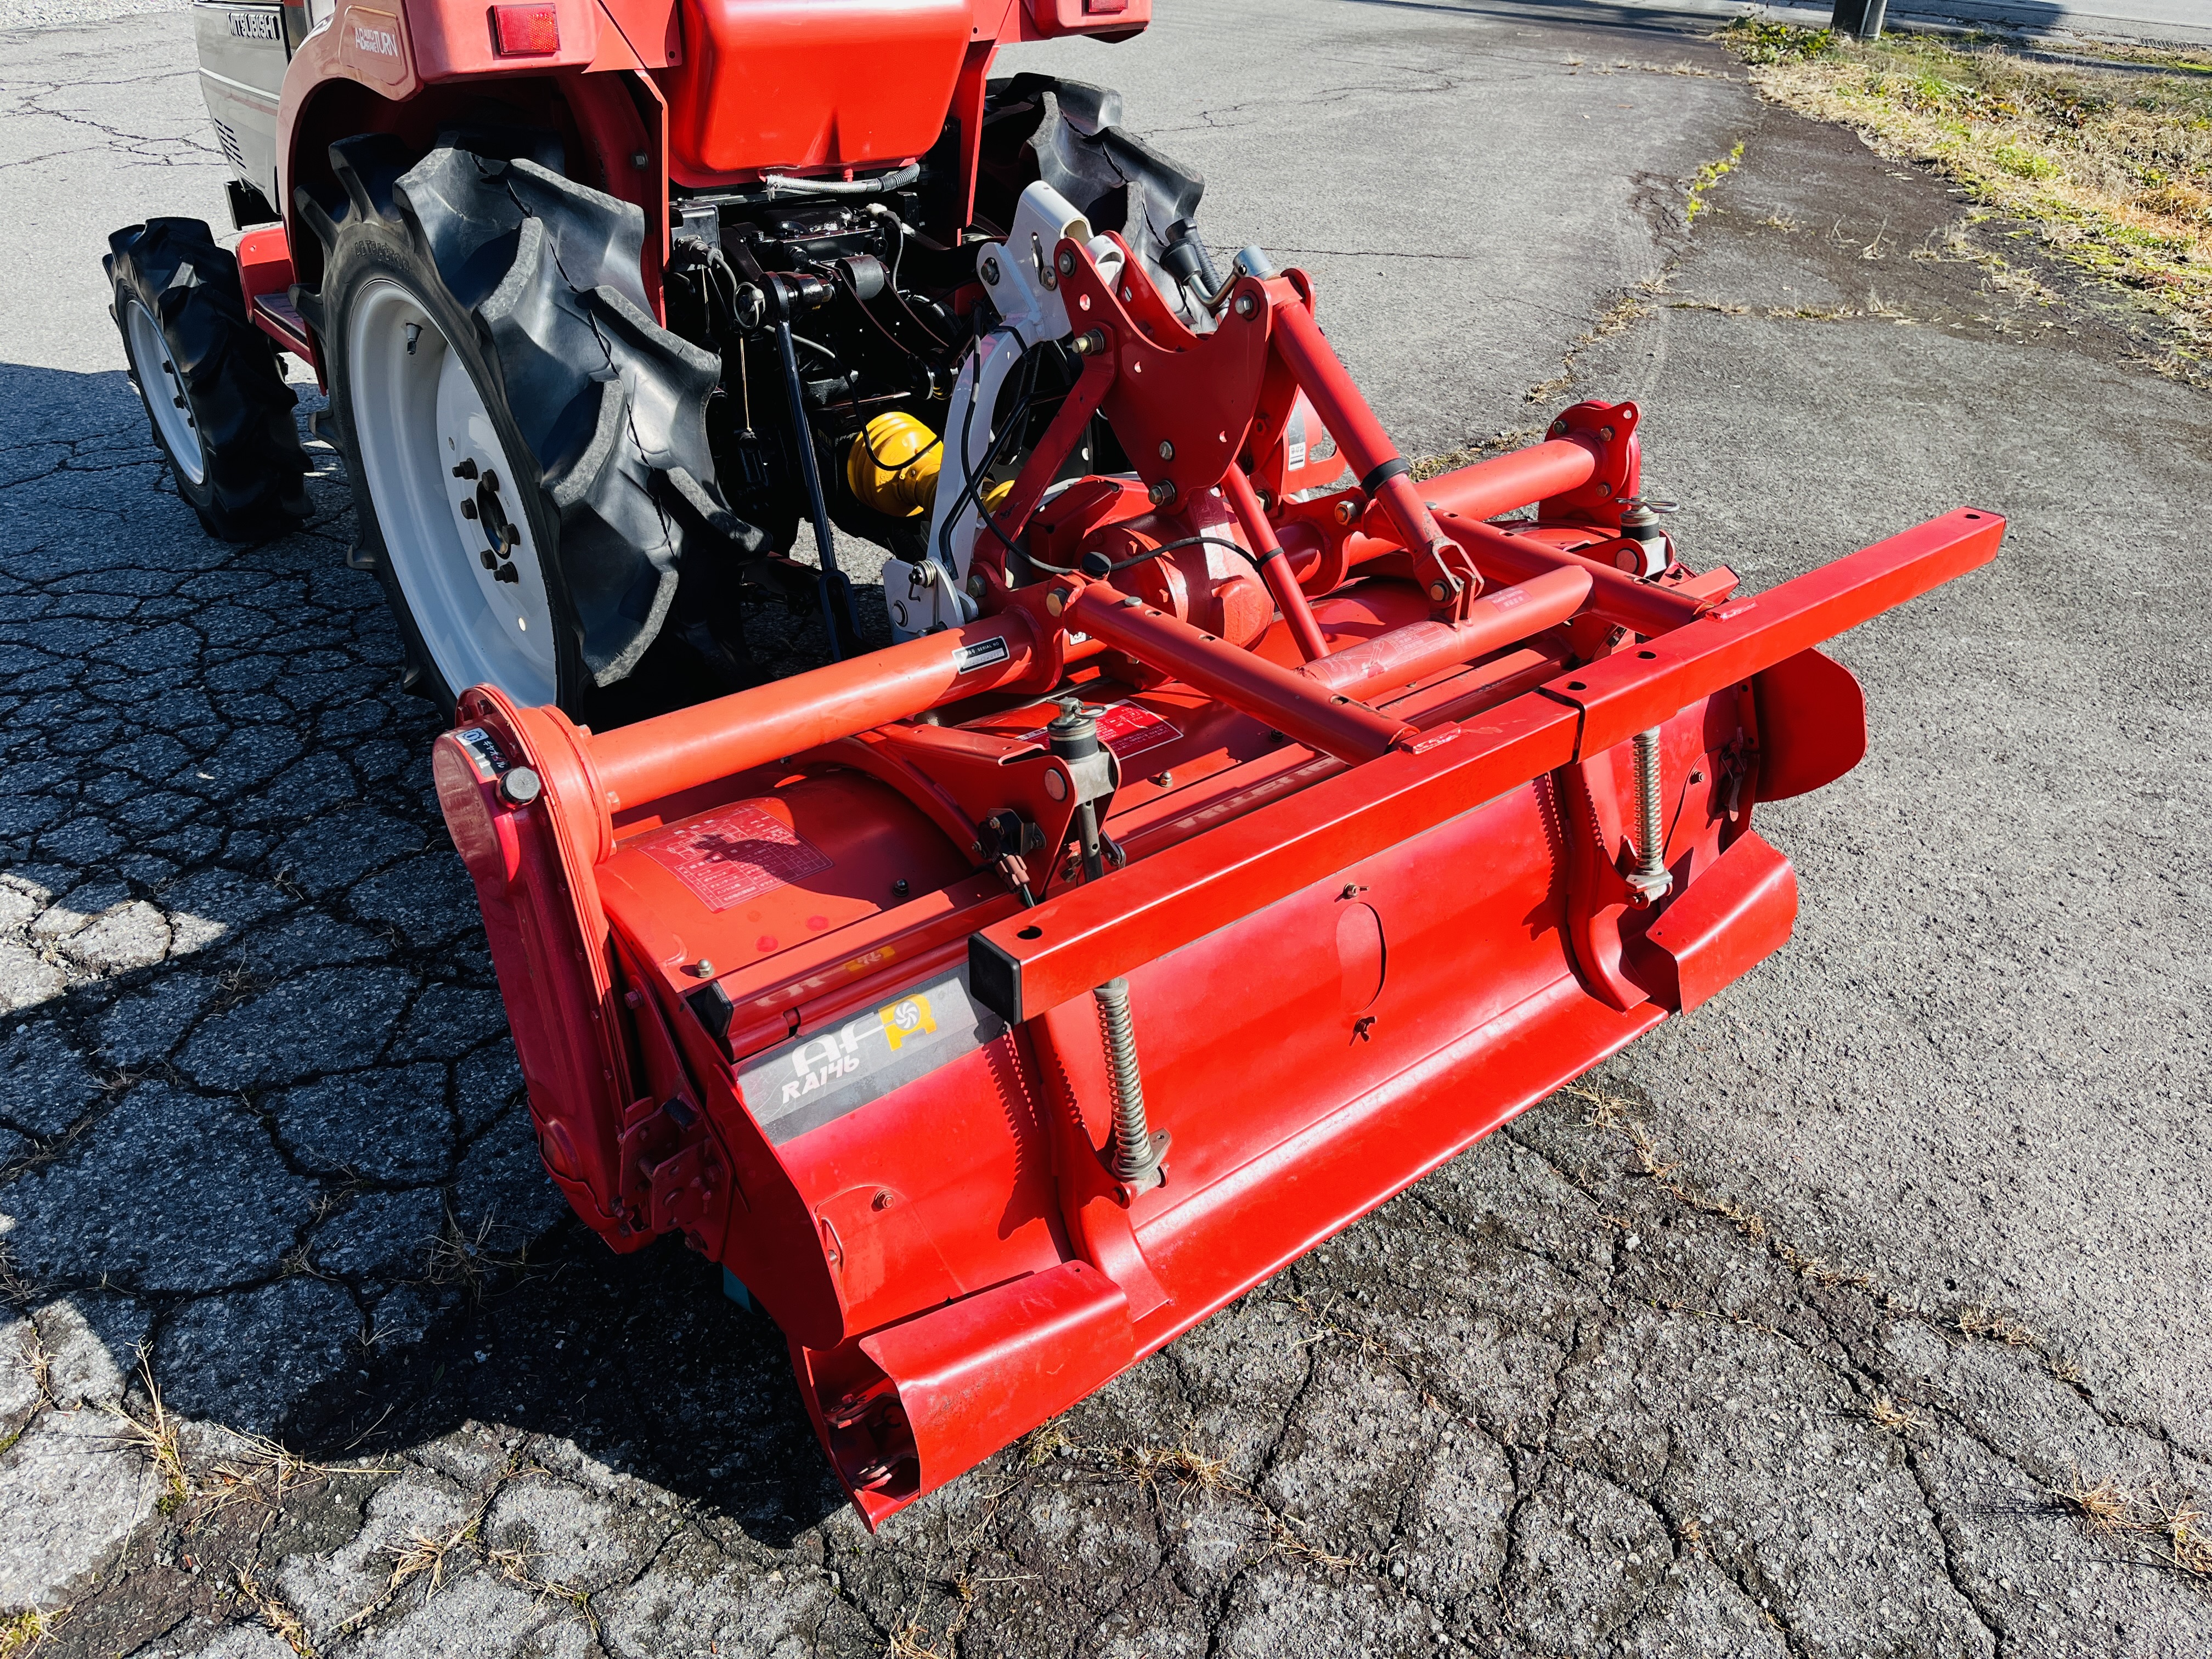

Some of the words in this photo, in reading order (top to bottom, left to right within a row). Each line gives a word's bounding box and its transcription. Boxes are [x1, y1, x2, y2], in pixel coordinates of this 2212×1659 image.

[227, 13, 278, 40] MITSUBISHI
[373, 30, 398, 57] TURN
[782, 1054, 860, 1104] RA146
